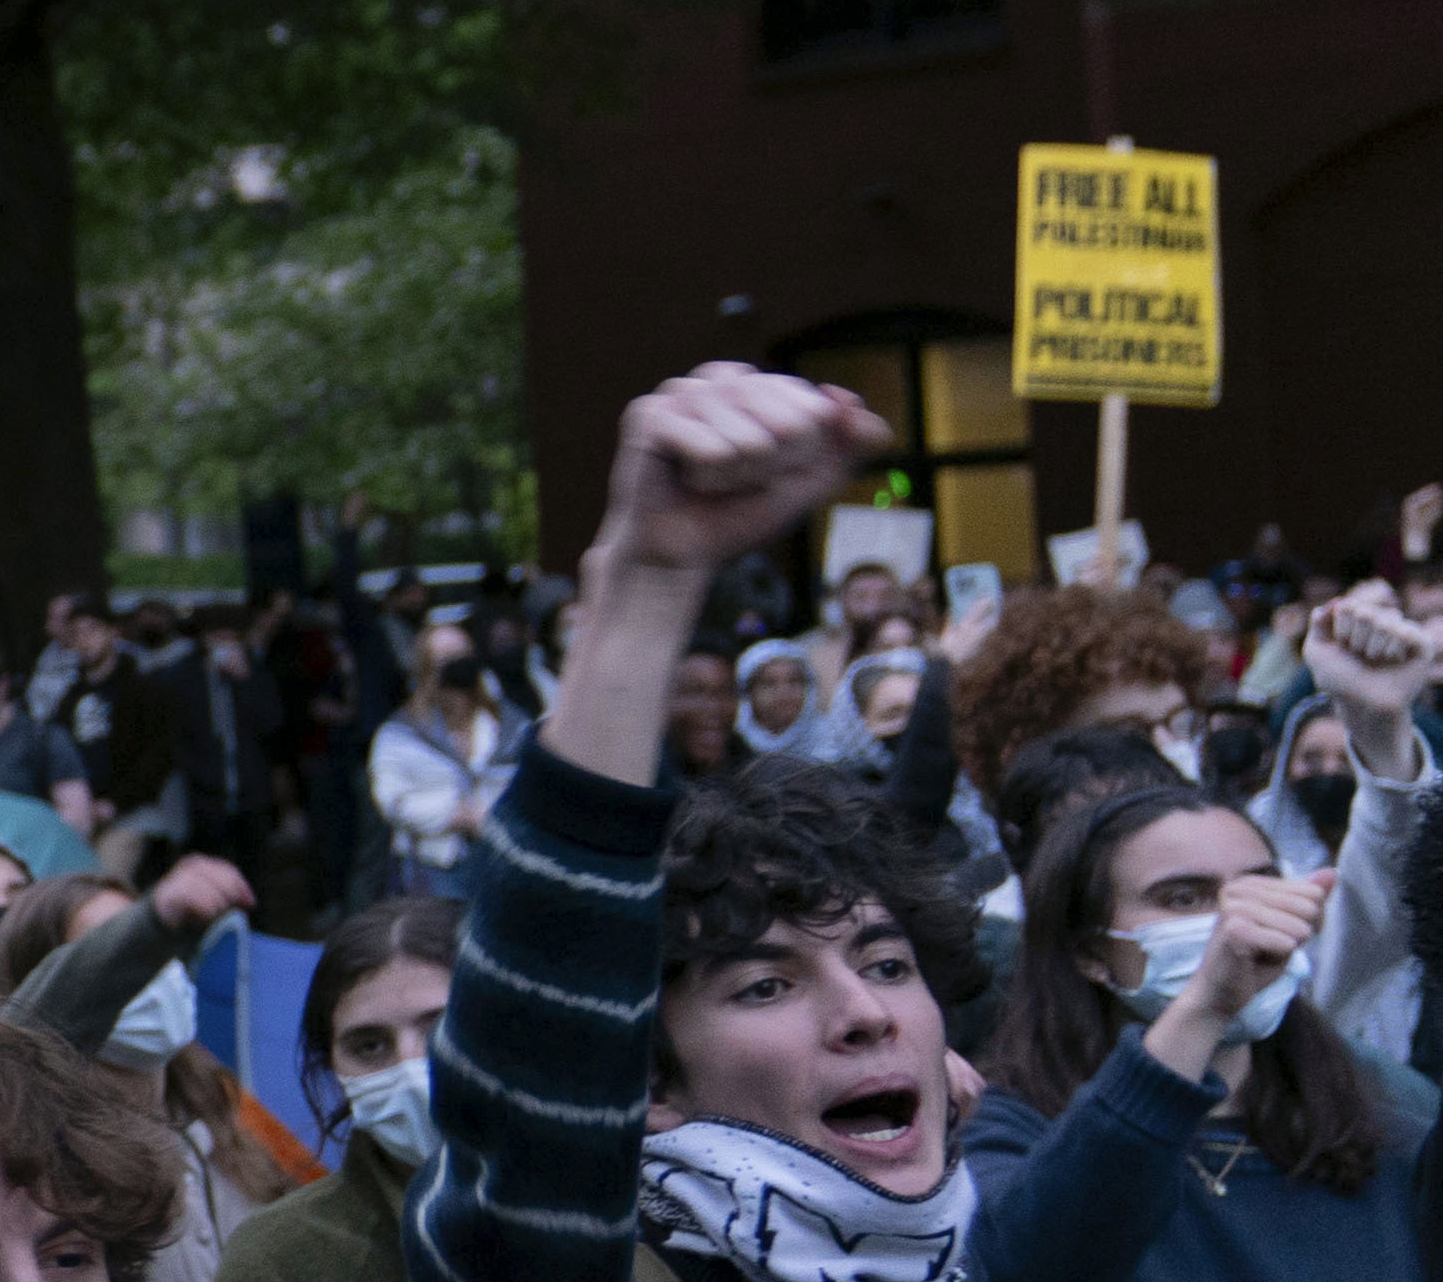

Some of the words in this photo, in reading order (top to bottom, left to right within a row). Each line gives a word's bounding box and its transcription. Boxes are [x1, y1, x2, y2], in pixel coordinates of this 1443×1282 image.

[1033, 170, 1128, 210] FREE
[1144, 174, 1201, 217] ALL
[1033, 286, 1200, 327] POLITICAL
